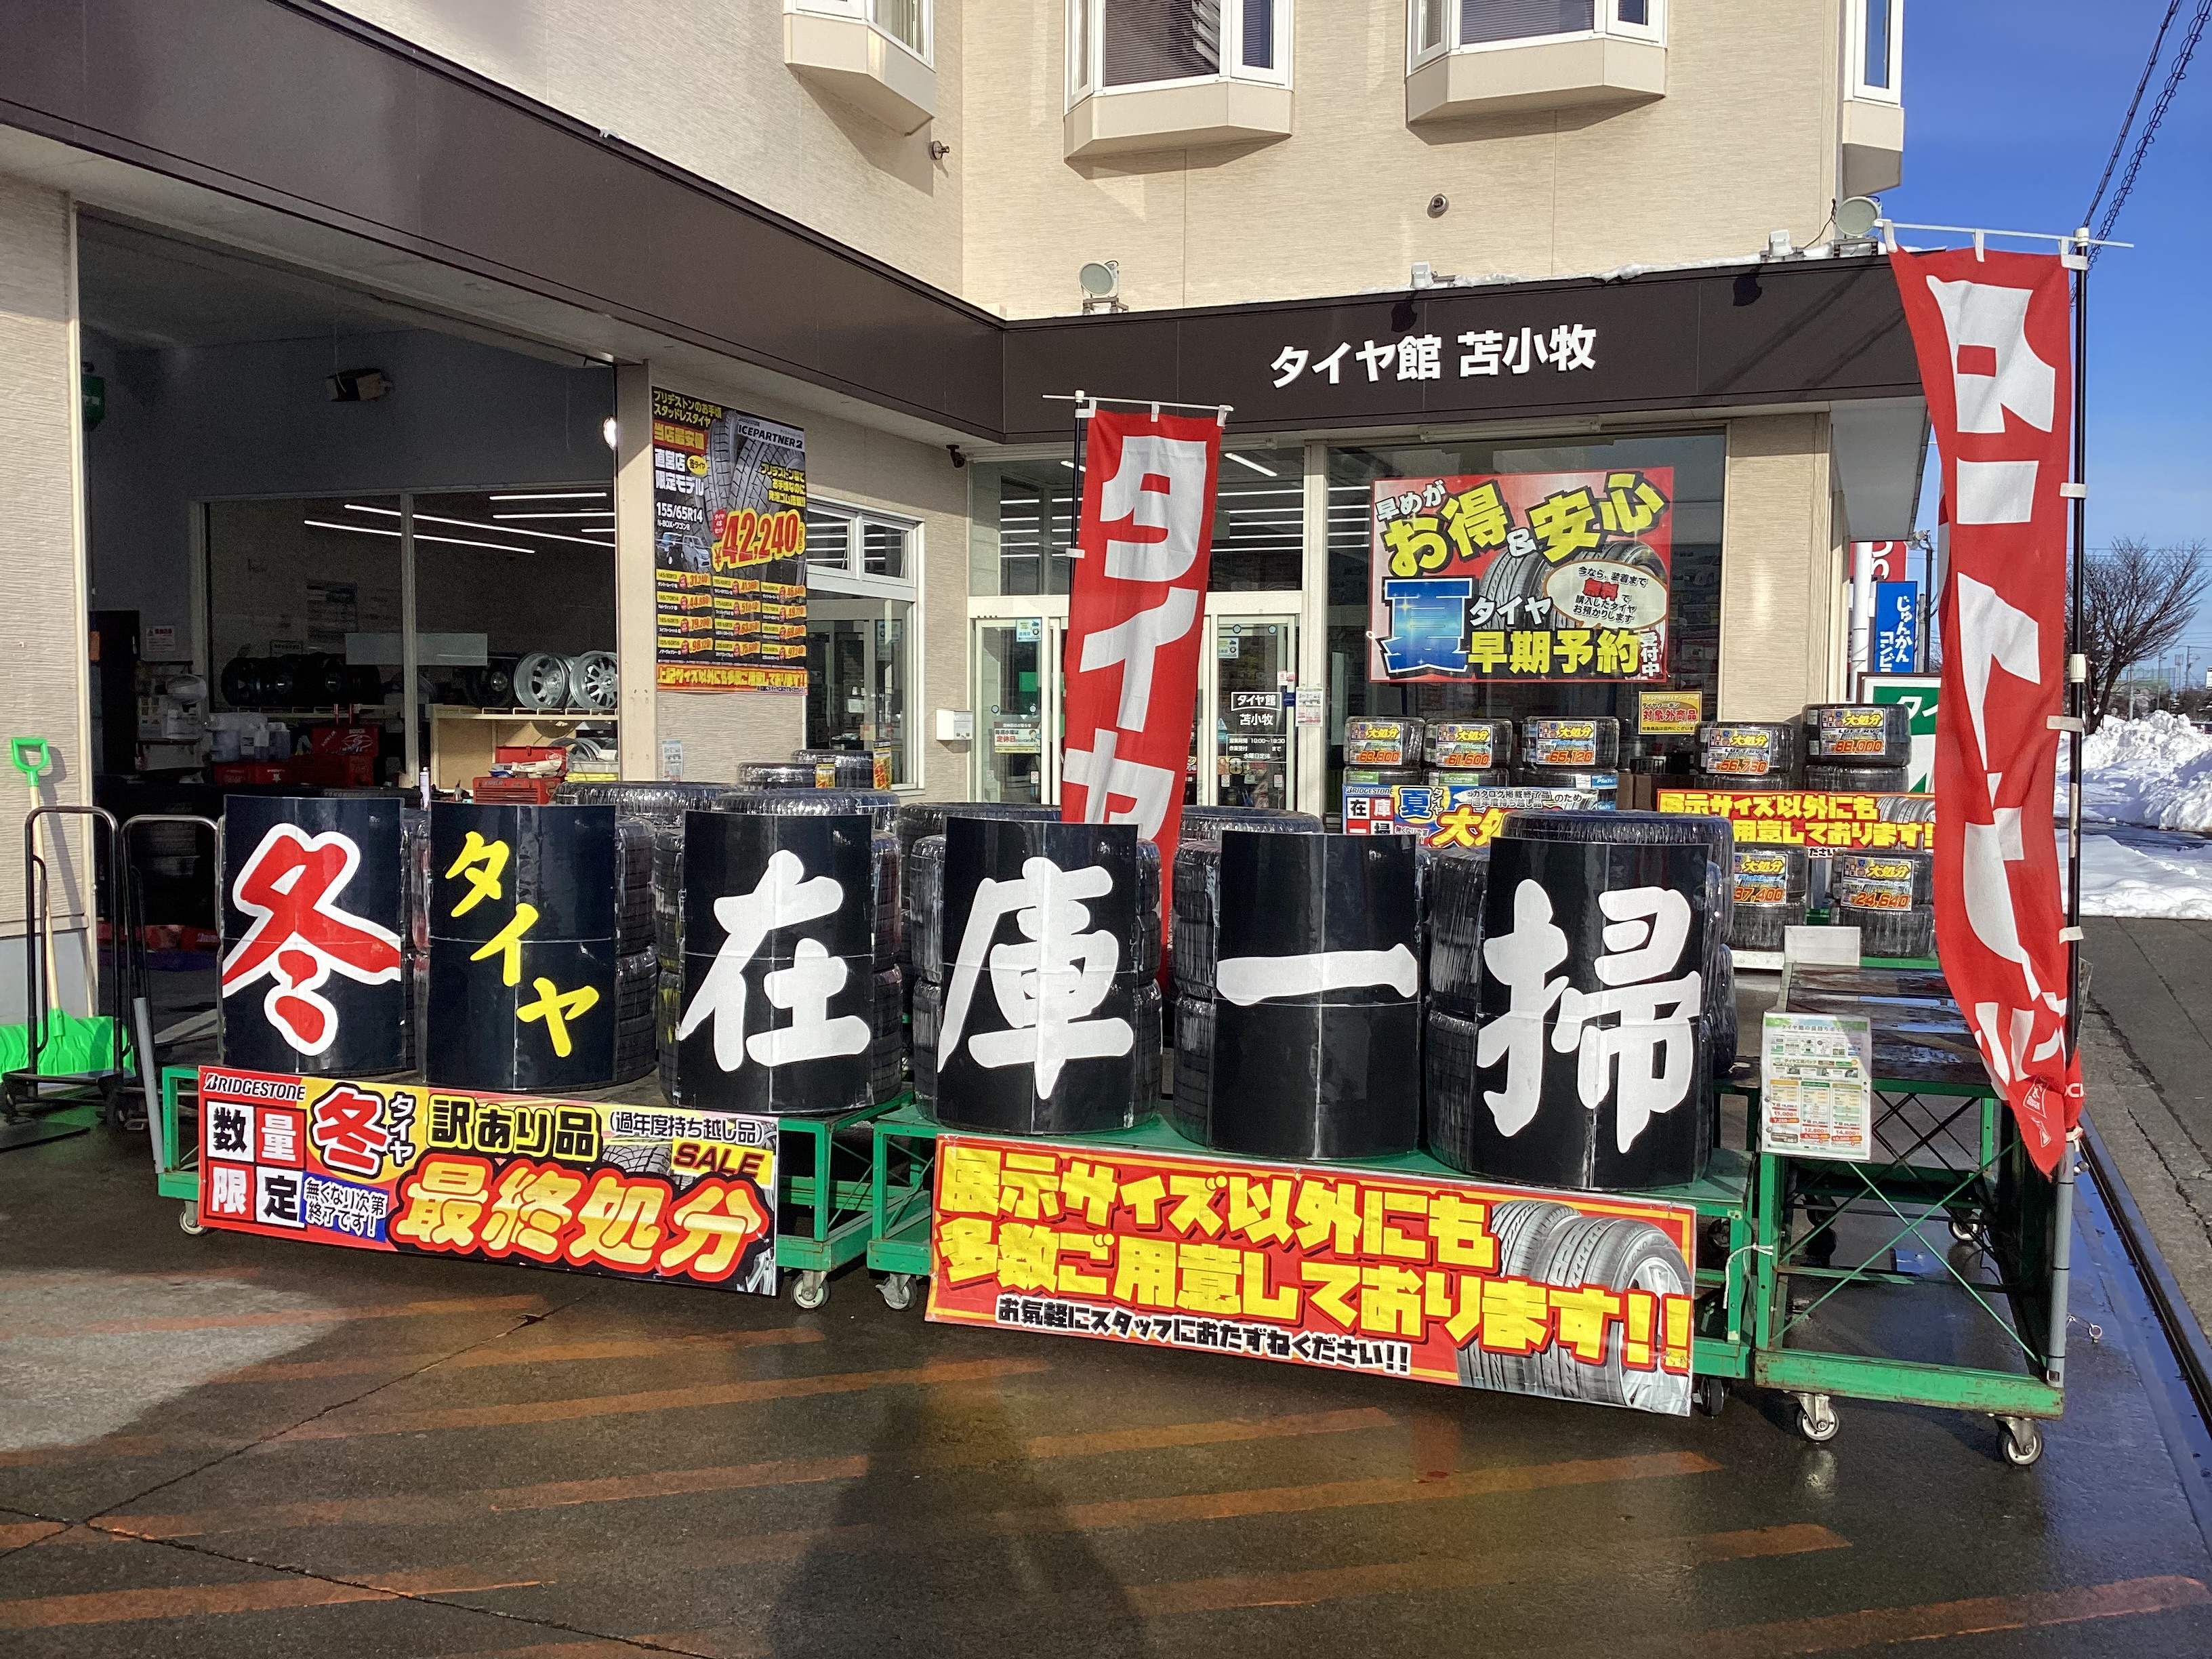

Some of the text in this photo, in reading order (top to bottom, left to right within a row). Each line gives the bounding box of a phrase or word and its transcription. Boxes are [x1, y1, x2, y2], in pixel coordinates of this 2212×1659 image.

[1270, 324, 1597, 388] タイヤ館 苫小牧
[656, 501, 703, 523] 155/65R14
[1376, 480, 1446, 520] 早めが
[1578, 566, 1647, 588] 今なら、装着まで
[1573, 605, 1634, 623] お預かりします
[1576, 595, 1637, 613] 購入したタイヤ
[1382, 578, 1553, 673] 夏 タイヤ
[1896, 595, 1912, 663] じゅんかん
[1468, 630, 1639, 674] 早期予約
[1237, 695, 1276, 706] タイヤ館
[1240, 713, 1273, 726] 苫小牧
[1643, 709, 1698, 722] 対象外商品
[1844, 714, 1882, 727] 大処分
[1367, 727, 1400, 739] 大処分
[1456, 730, 1490, 741] 大処分
[1558, 726, 1592, 738] 大処分
[1730, 735, 1767, 747] 大処分
[1350, 800, 1391, 817] 在庫
[1399, 789, 1445, 819] 夏 タイヤ
[1555, 794, 1582, 803] のため
[1659, 793, 1879, 819] 展示サイズ以外にも
[1744, 861, 1783, 873] 大処分
[1868, 865, 1909, 878] 大処分
[224, 823, 401, 1056] 冬
[445, 831, 599, 1058] タイヤ
[203, 1073, 305, 1101] BRIDGESTONE
[213, 1107, 297, 1162] 数量
[314, 1086, 388, 1176] 冬
[388, 1093, 416, 1166] タイヤ
[432, 1098, 597, 1159] 訳あり品
[673, 1143, 766, 1178] SALE
[211, 1166, 305, 1220] 限定
[306, 1179, 386, 1216] 無くなり次第
[396, 1161, 764, 1274] 最終処分
[939, 1145, 1498, 1269] 展示サイズ以外にも
[938, 1216, 1692, 1369] 多数ご用意しております!!
[997, 1296, 1412, 1374] お気軽にスタッフにおたずねください!!
